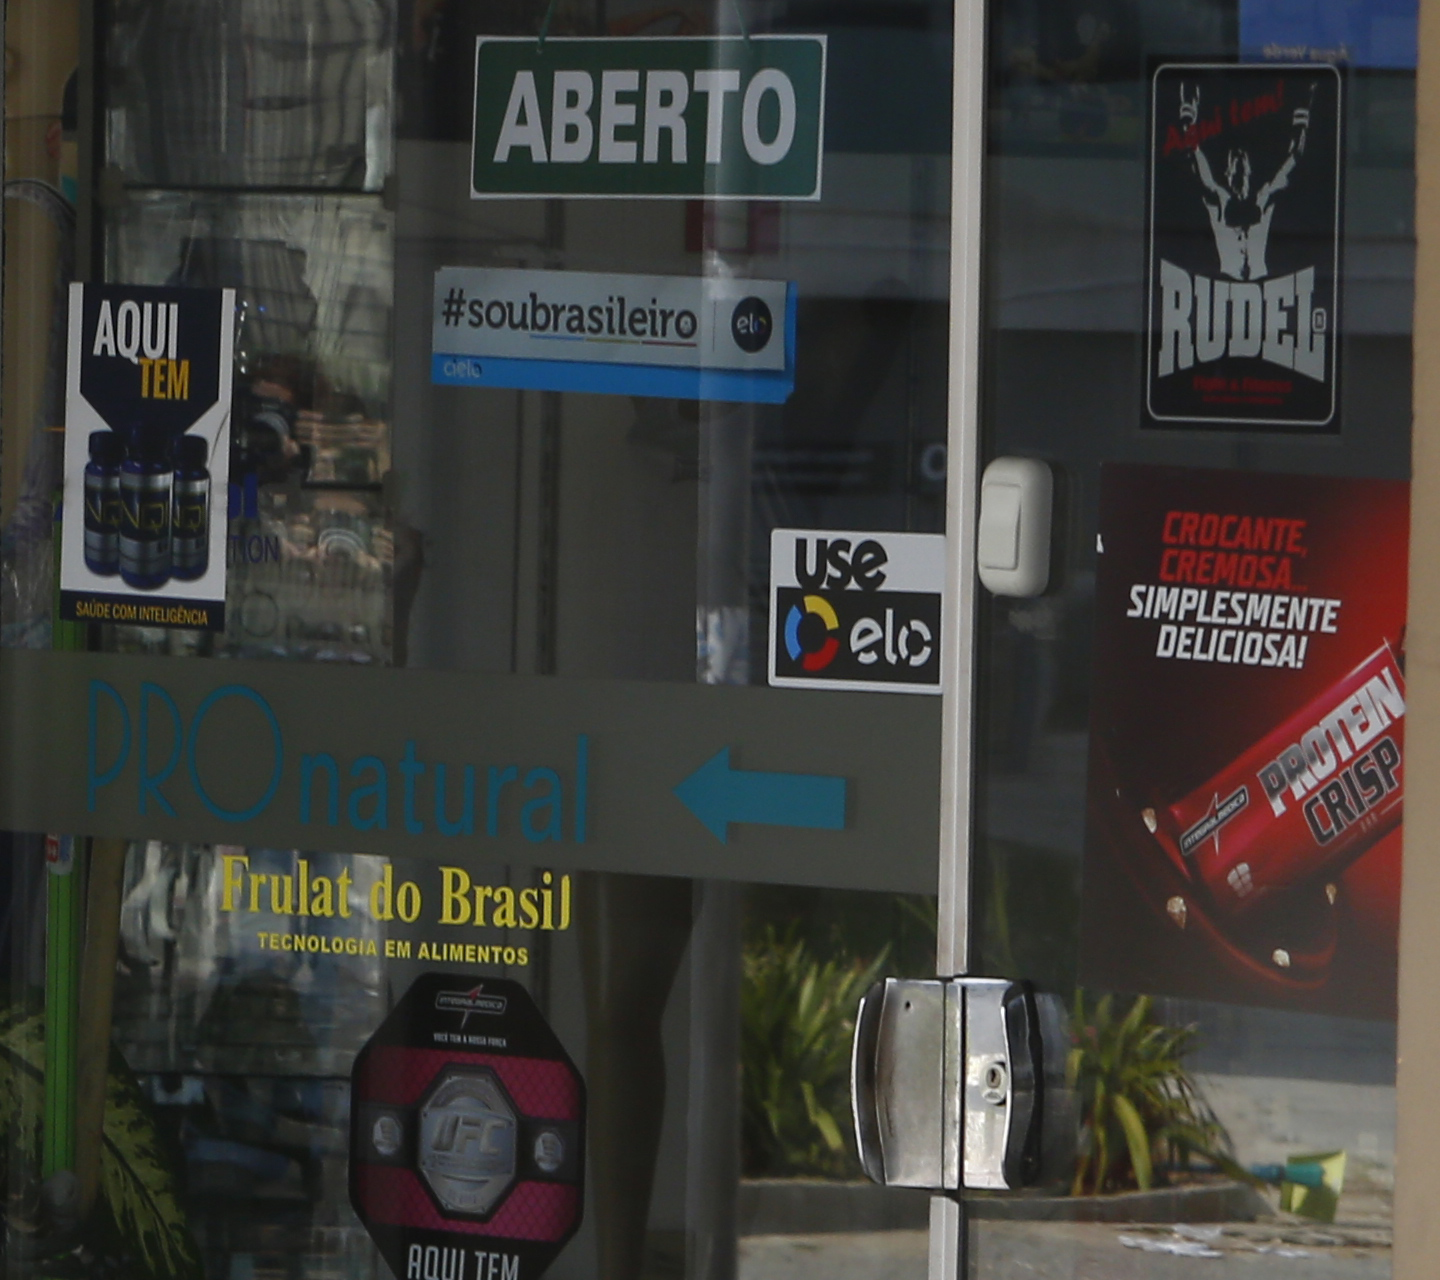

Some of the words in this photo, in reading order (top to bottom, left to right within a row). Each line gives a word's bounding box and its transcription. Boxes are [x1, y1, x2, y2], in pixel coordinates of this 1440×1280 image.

[493, 68, 797, 165] ABERTO
[92, 299, 179, 365] AQUI
[442, 287, 698, 340] #soubrasileiro
[736, 314, 768, 337] elo
[1158, 258, 1325, 383] RUDEL
[138, 357, 190, 400] TEM
[443, 358, 483, 378] cielo
[1161, 511, 1308, 557] CROCANTE,
[795, 538, 889, 592] use
[76, 598, 110, 619] SAÚDE
[112, 603, 137, 620] COM
[139, 603, 209, 626] INTELIGÊNCIA
[1126, 584, 1342, 634] SIMPLESMENTE
[849, 607, 933, 668] elo
[1156, 623, 1309, 669] DELICIOSA!
[1256, 666, 1406, 818] PROTEIN
[1302, 735, 1402, 847] CRISP
[220, 855, 353, 919] Frulat
[368, 863, 422, 923] do
[438, 866, 572, 931] Brasil
[257, 931, 378, 956] TECNOLOGIA
[384, 939, 412, 960] EM
[417, 942, 529, 967] ALIMENTOS
